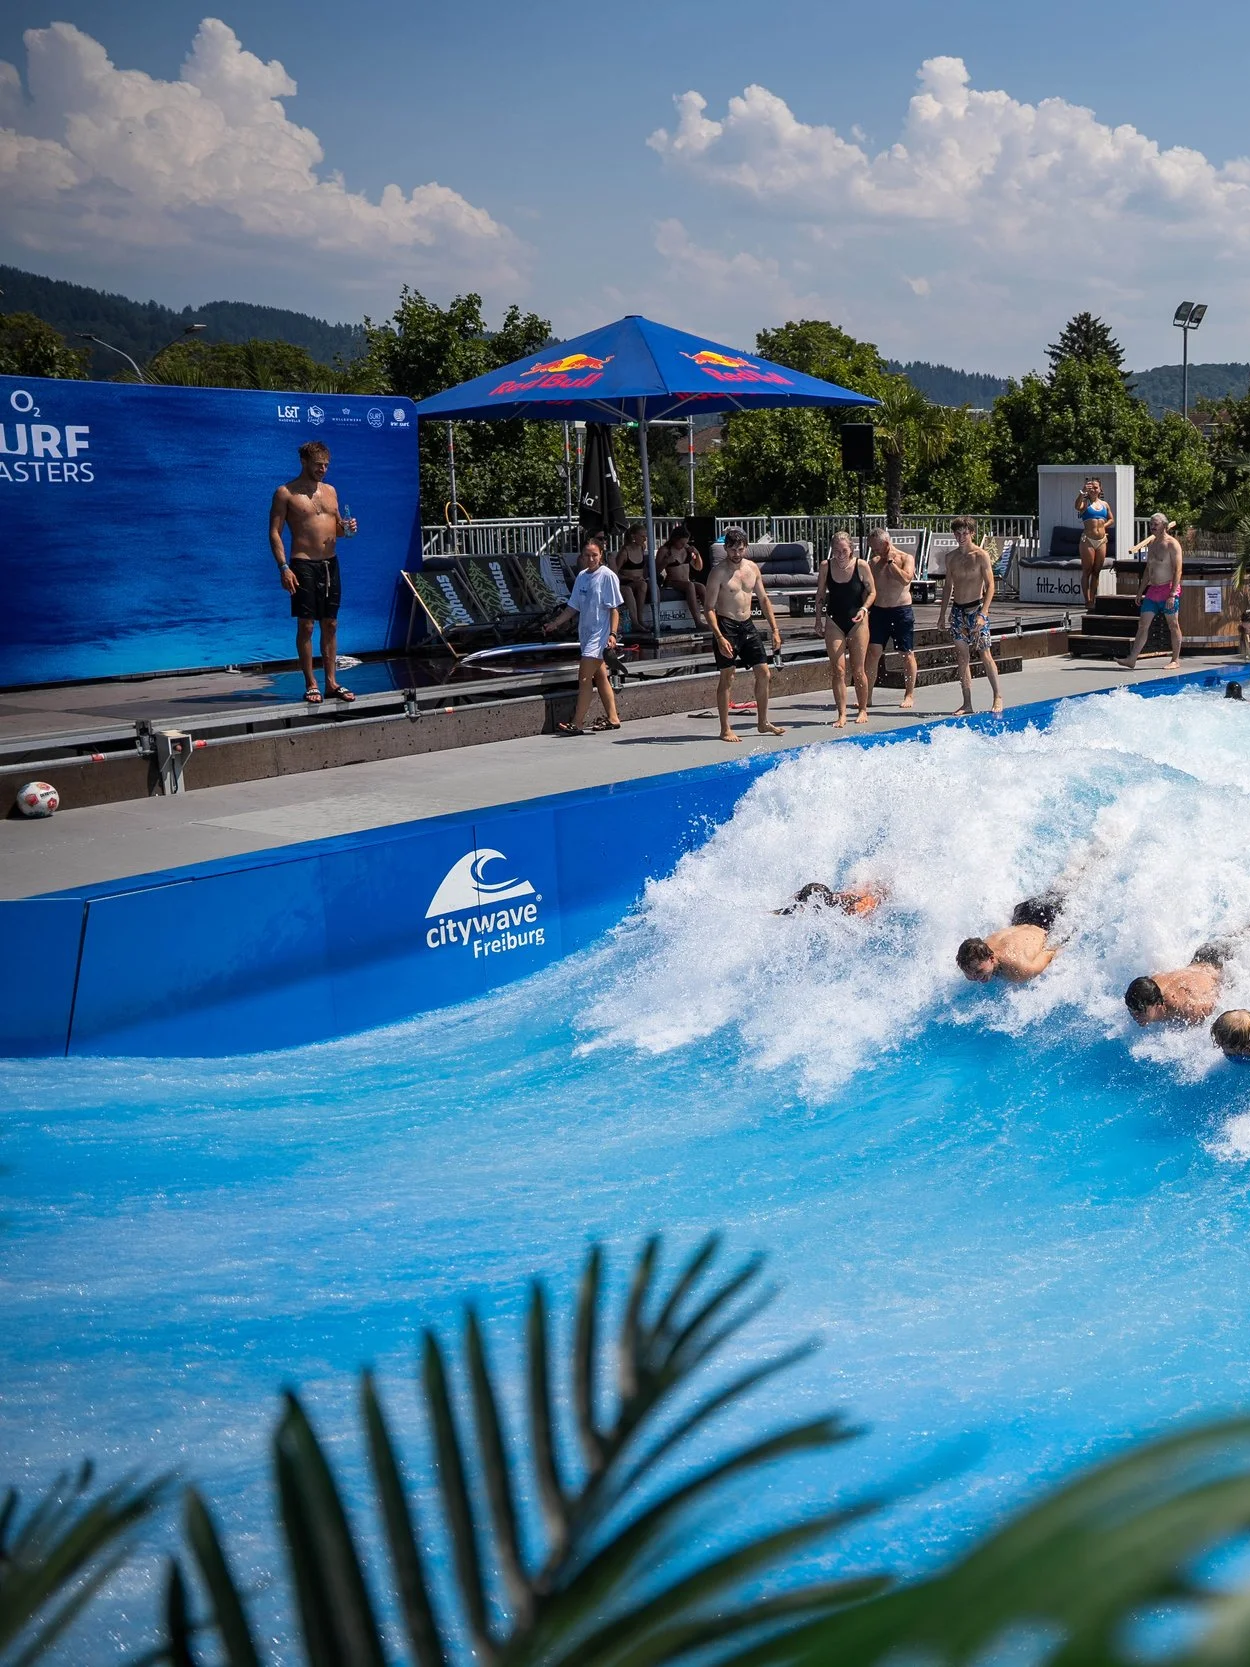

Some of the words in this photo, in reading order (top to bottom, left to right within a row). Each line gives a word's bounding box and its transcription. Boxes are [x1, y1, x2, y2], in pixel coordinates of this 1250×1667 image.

[488, 374, 548, 396] Red
[539, 373, 604, 389] Bull
[701, 367, 744, 382] Red
[735, 368, 795, 386] Bull
[277, 405, 300, 418] L&T
[1036, 577, 1081, 595] fritz-kola
[473, 928, 545, 958] Freiburg
